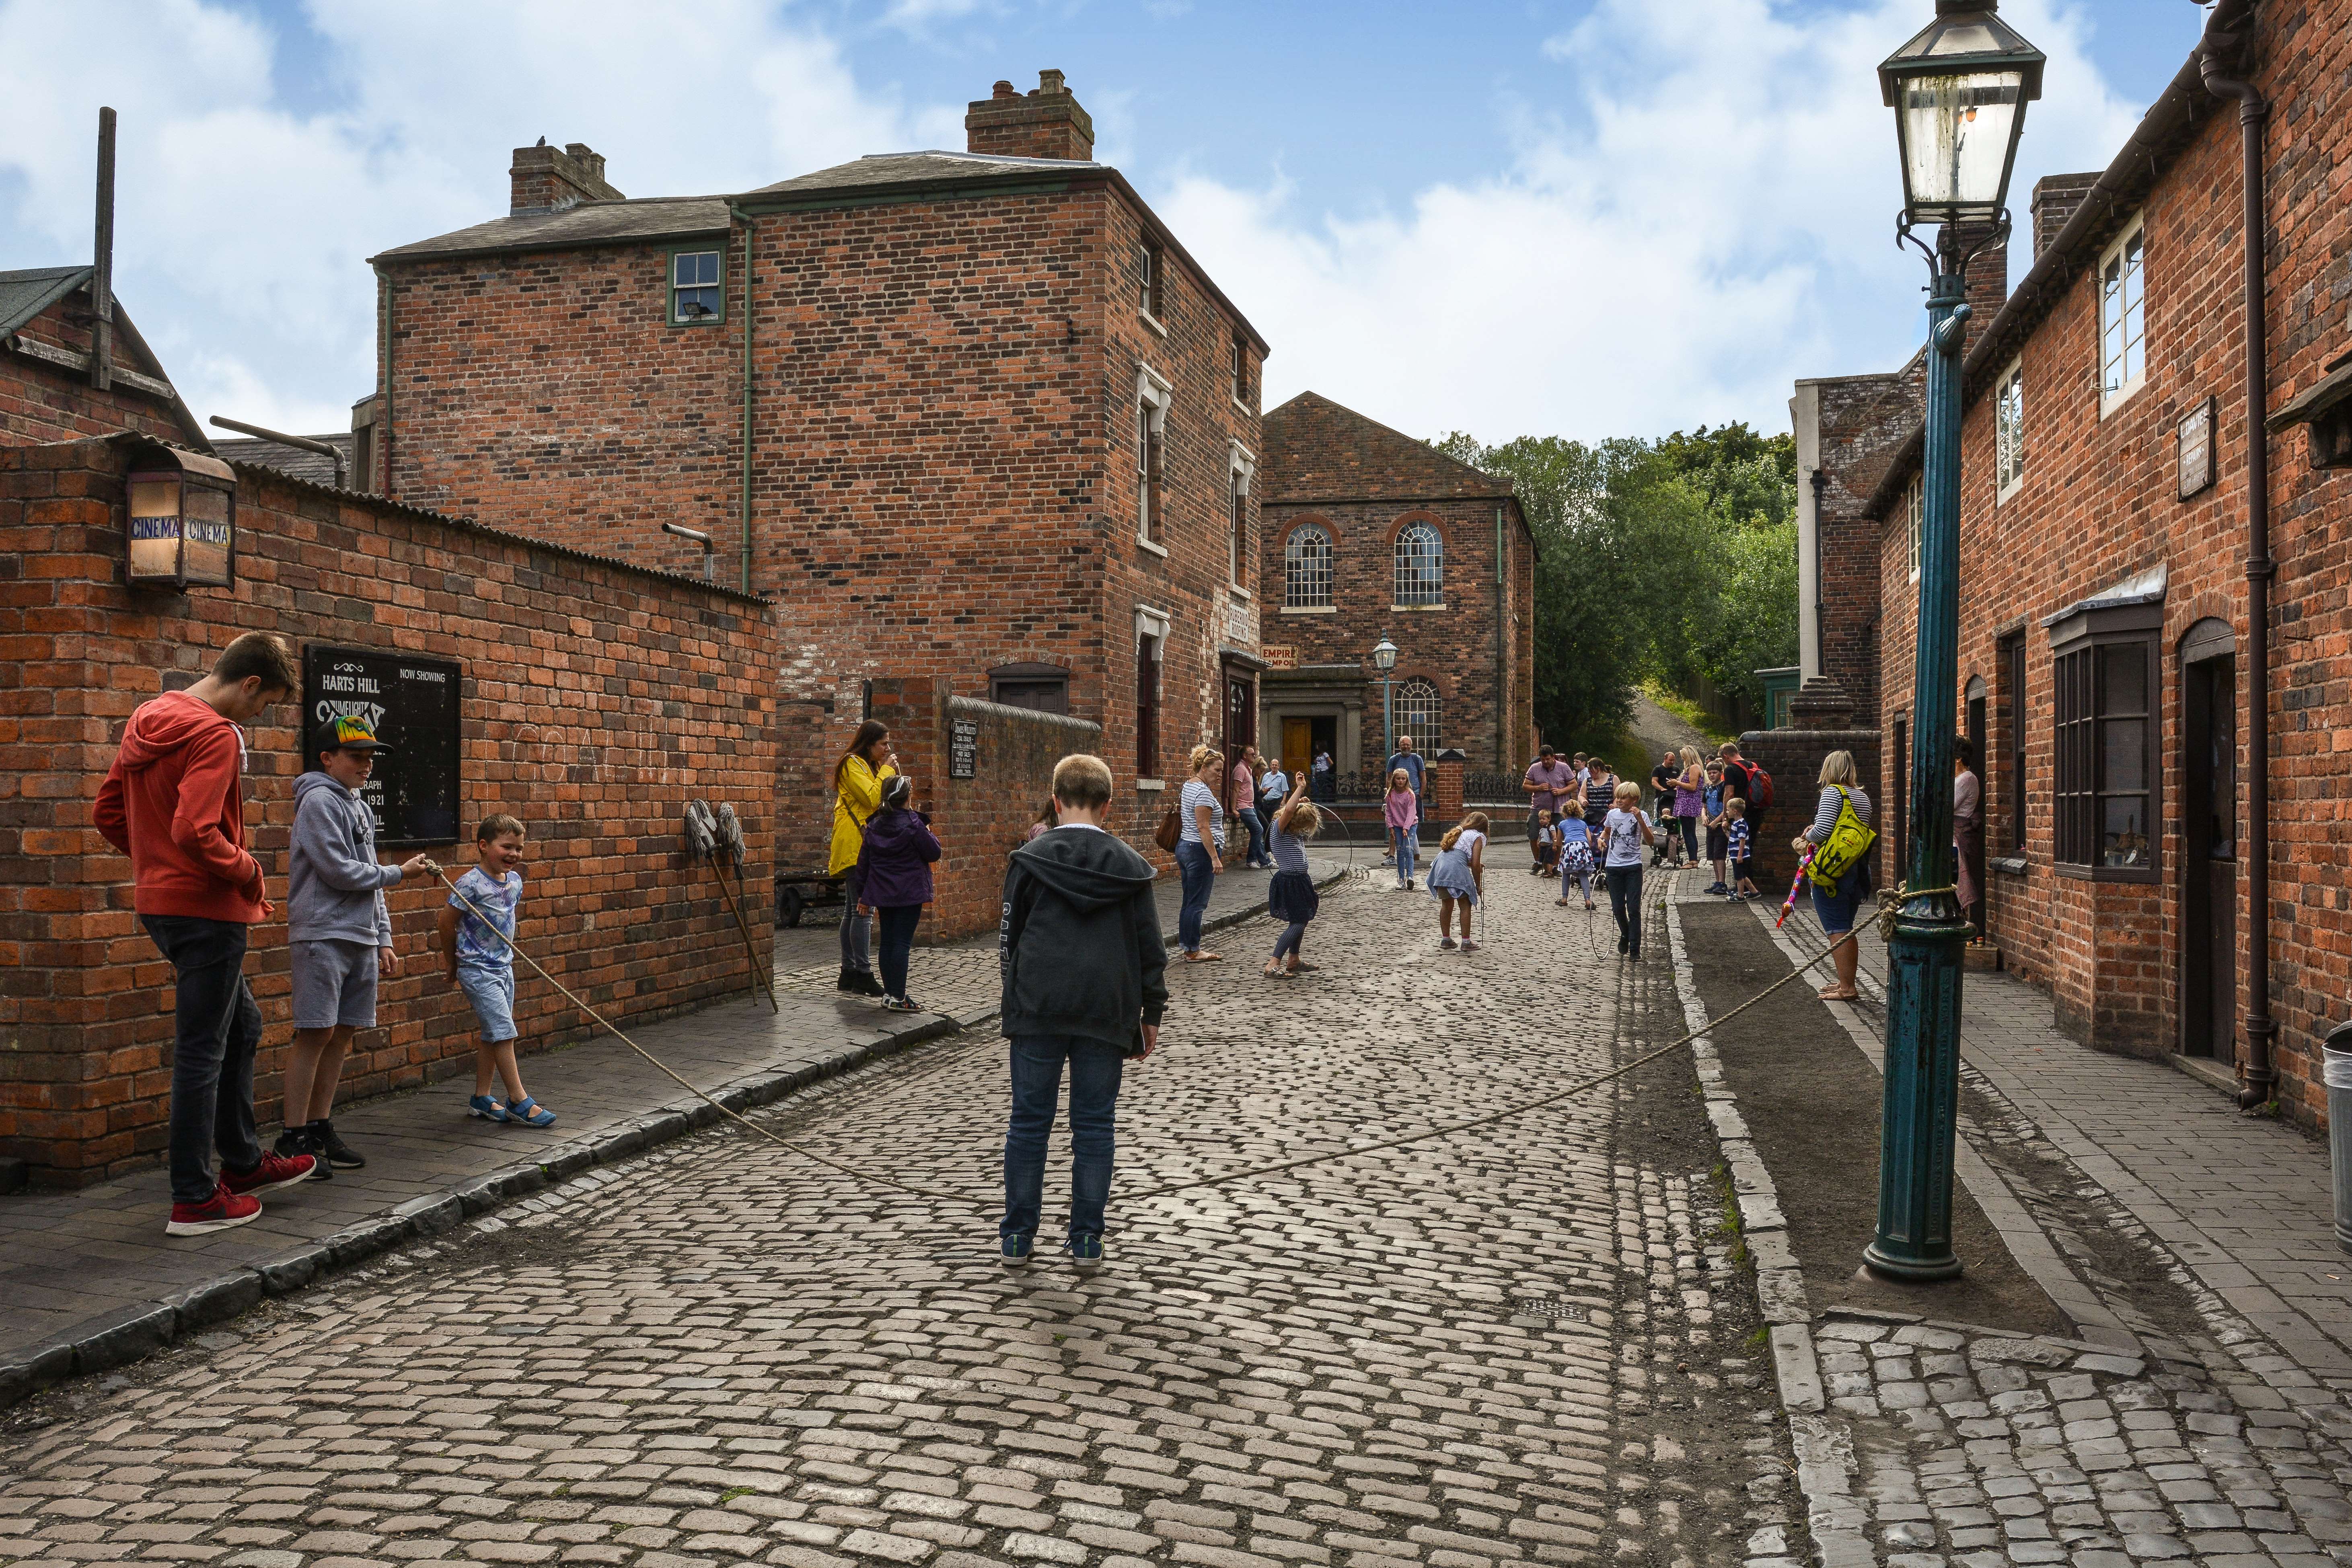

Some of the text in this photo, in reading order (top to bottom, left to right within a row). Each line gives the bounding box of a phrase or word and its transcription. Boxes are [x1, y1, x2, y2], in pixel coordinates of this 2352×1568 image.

[2186, 446, 2202, 466] REPAIRS
[132, 517, 179, 538] CINEMA
[189, 520, 228, 544] CINEMA
[1230, 607, 1248, 627] RUBEROID
[1232, 622, 1246, 639] ROOFING
[1263, 649, 1295, 658] EMPIRE
[323, 675, 380, 694] HARTS HILL
[400, 668, 446, 682] NOW SHOWING
[368, 795, 384, 805] 1921
